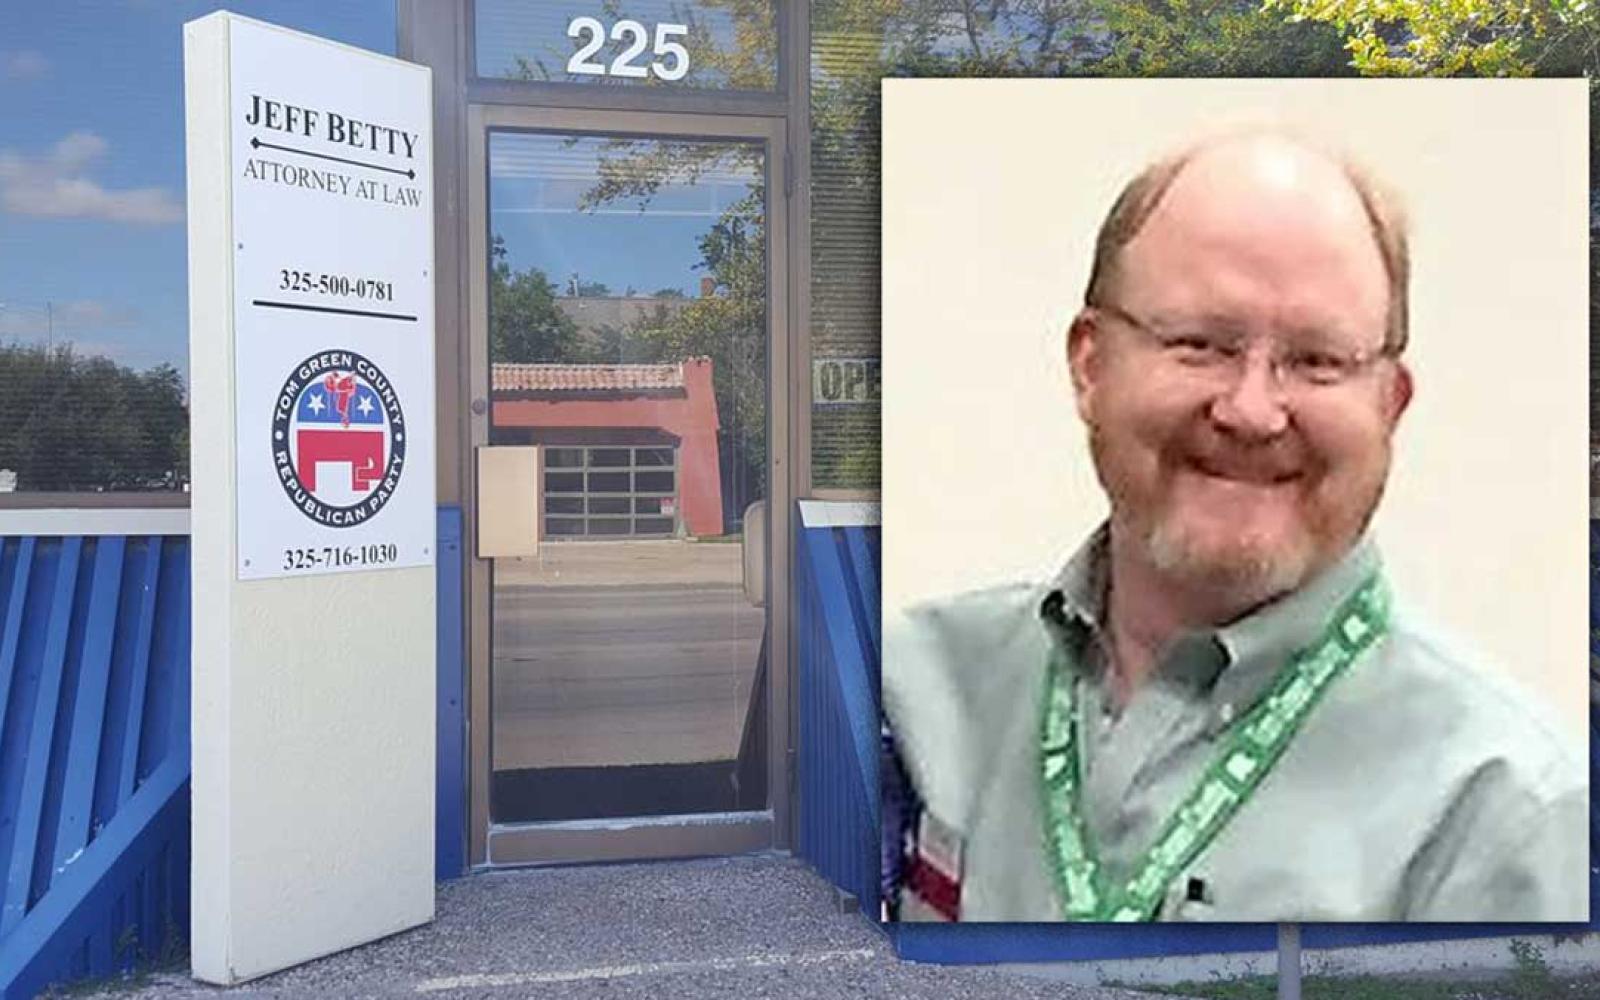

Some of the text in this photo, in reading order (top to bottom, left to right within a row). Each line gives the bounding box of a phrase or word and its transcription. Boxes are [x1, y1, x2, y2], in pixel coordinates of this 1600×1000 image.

[567, 17, 690, 81] 225
[246, 94, 418, 158] JEFF BETTY
[243, 158, 423, 208] ATTORNEY AT LAW
[279, 269, 394, 303] 325-500-0781
[276, 353, 401, 424] TOM GREEN COUNTY
[276, 451, 402, 524] REPUBLICAN PARTY
[283, 544, 397, 570] 325-716-1030
